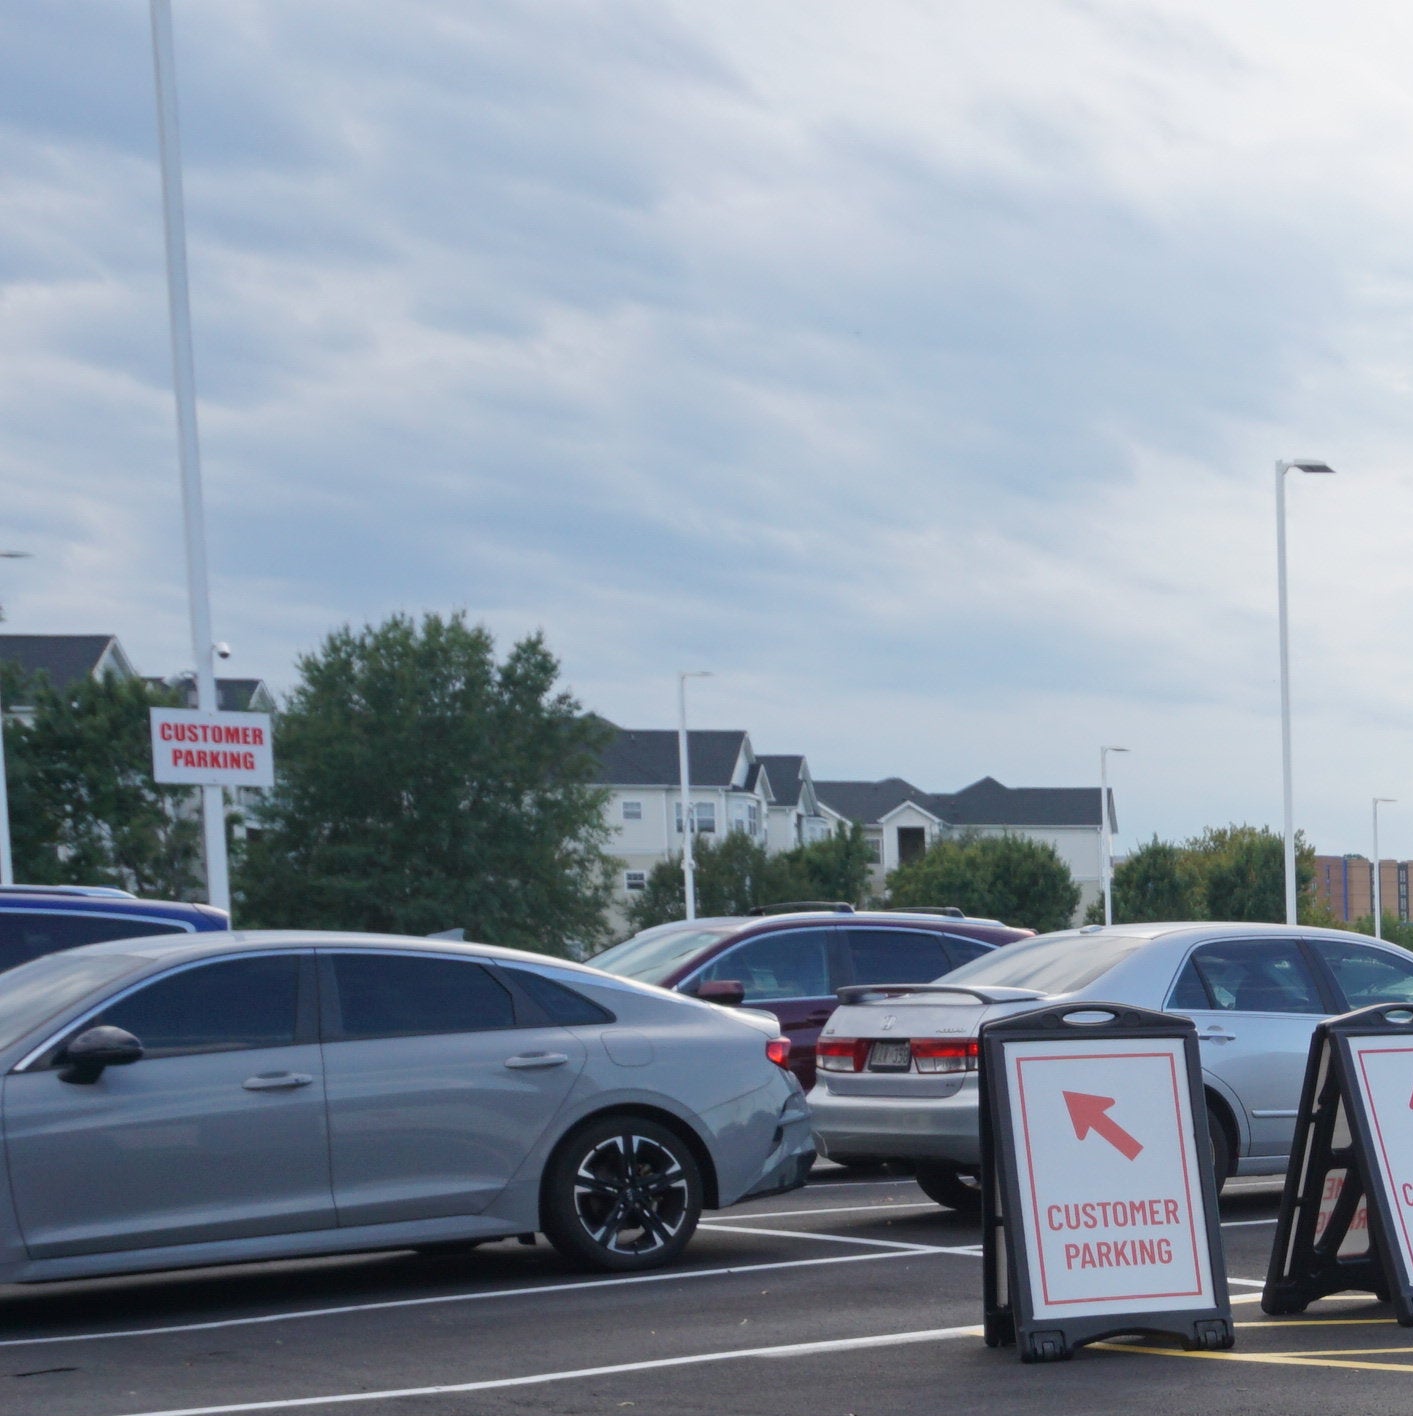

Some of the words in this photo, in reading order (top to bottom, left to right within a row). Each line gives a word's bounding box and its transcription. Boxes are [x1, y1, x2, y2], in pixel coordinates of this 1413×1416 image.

[160, 721, 264, 746] CUSTOMER
[171, 748, 256, 770] PARKING
[1047, 1199, 1181, 1231] CUSTOMER
[1064, 1238, 1173, 1270] PARKING
